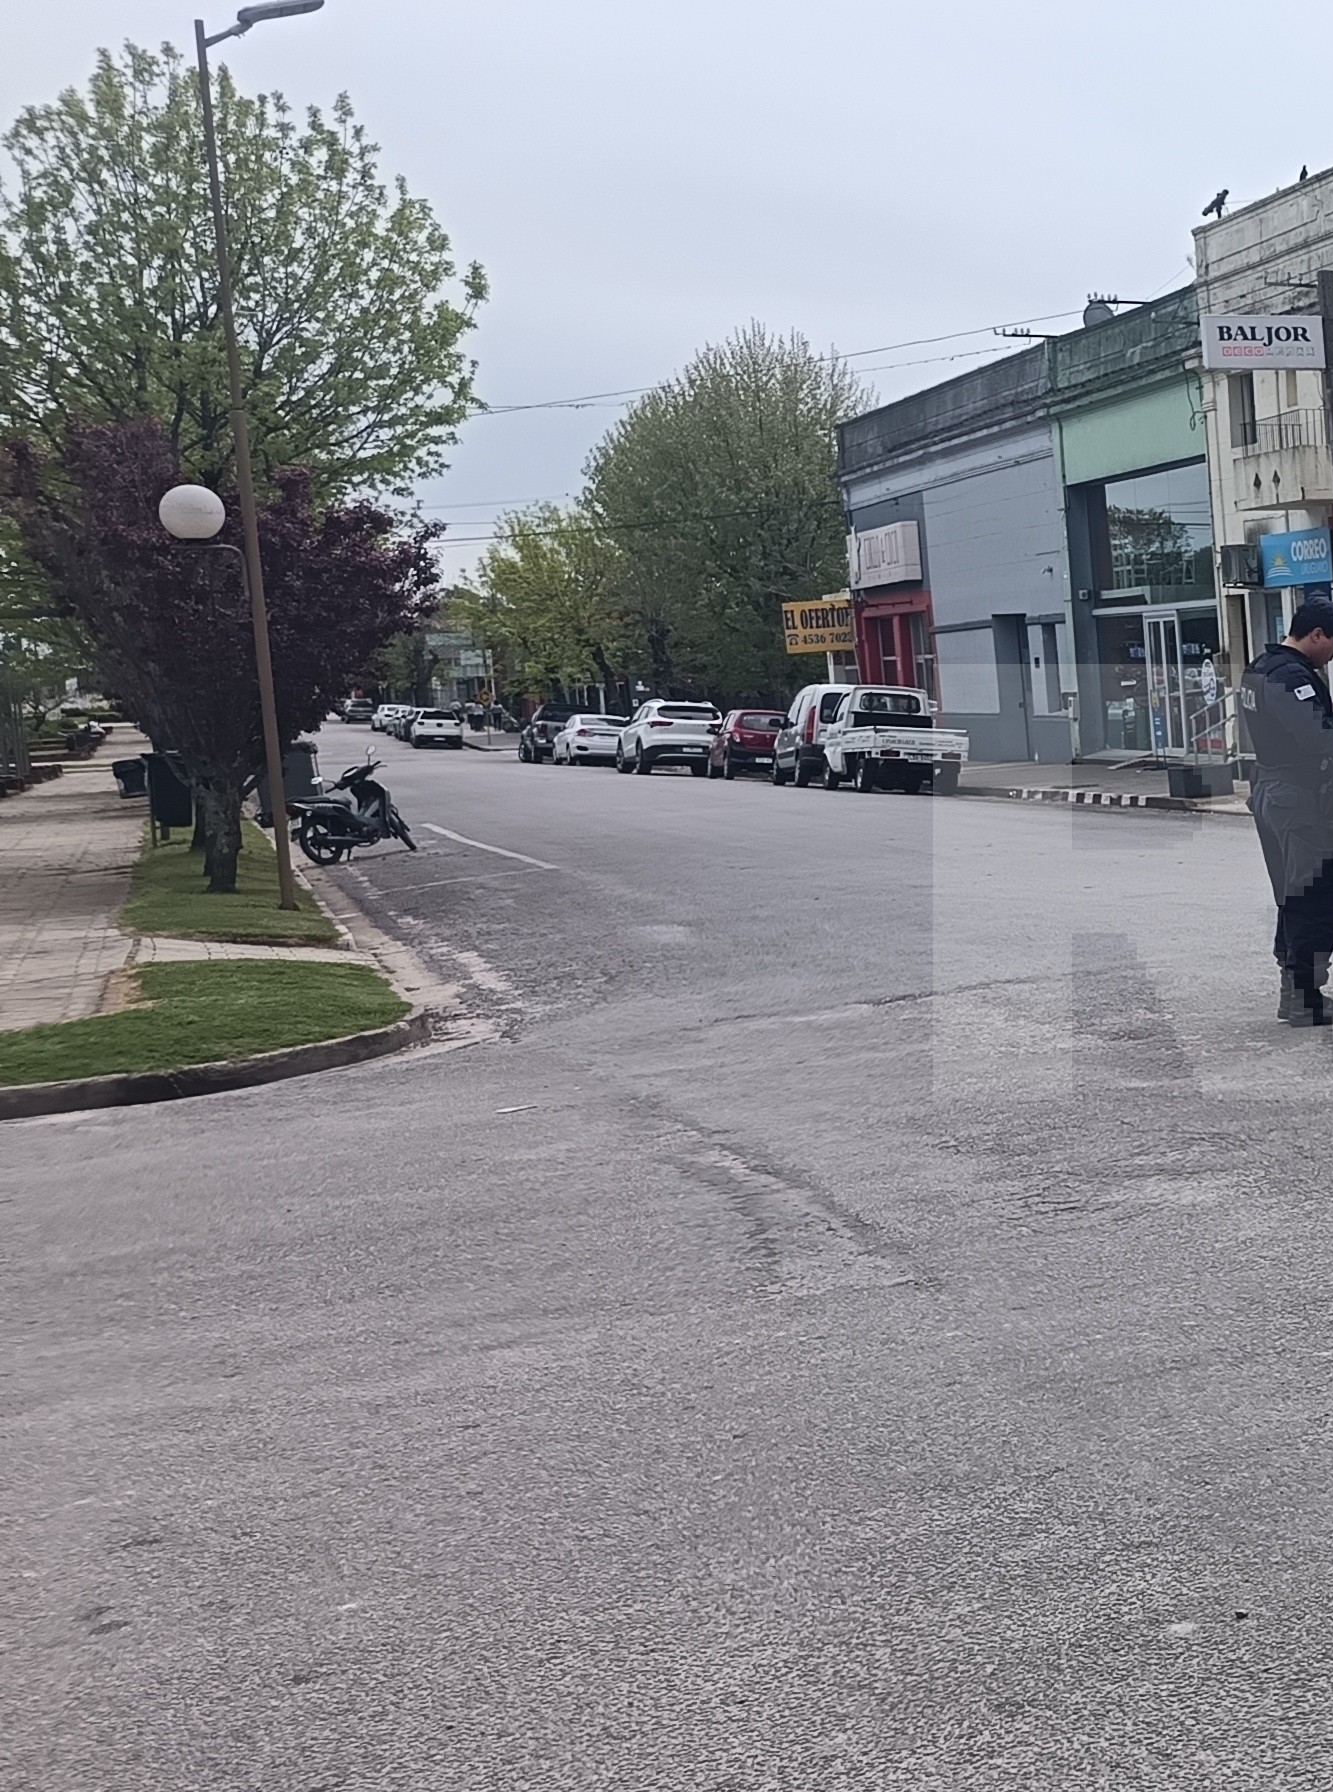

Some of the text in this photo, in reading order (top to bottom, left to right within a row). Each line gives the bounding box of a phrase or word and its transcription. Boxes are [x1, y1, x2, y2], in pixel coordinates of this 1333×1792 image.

[1217, 325, 1311, 347] BALJOR
[1291, 538, 1327, 562] CORREO
[784, 609, 798, 630] EL
[801, 631, 826, 646] 4536
